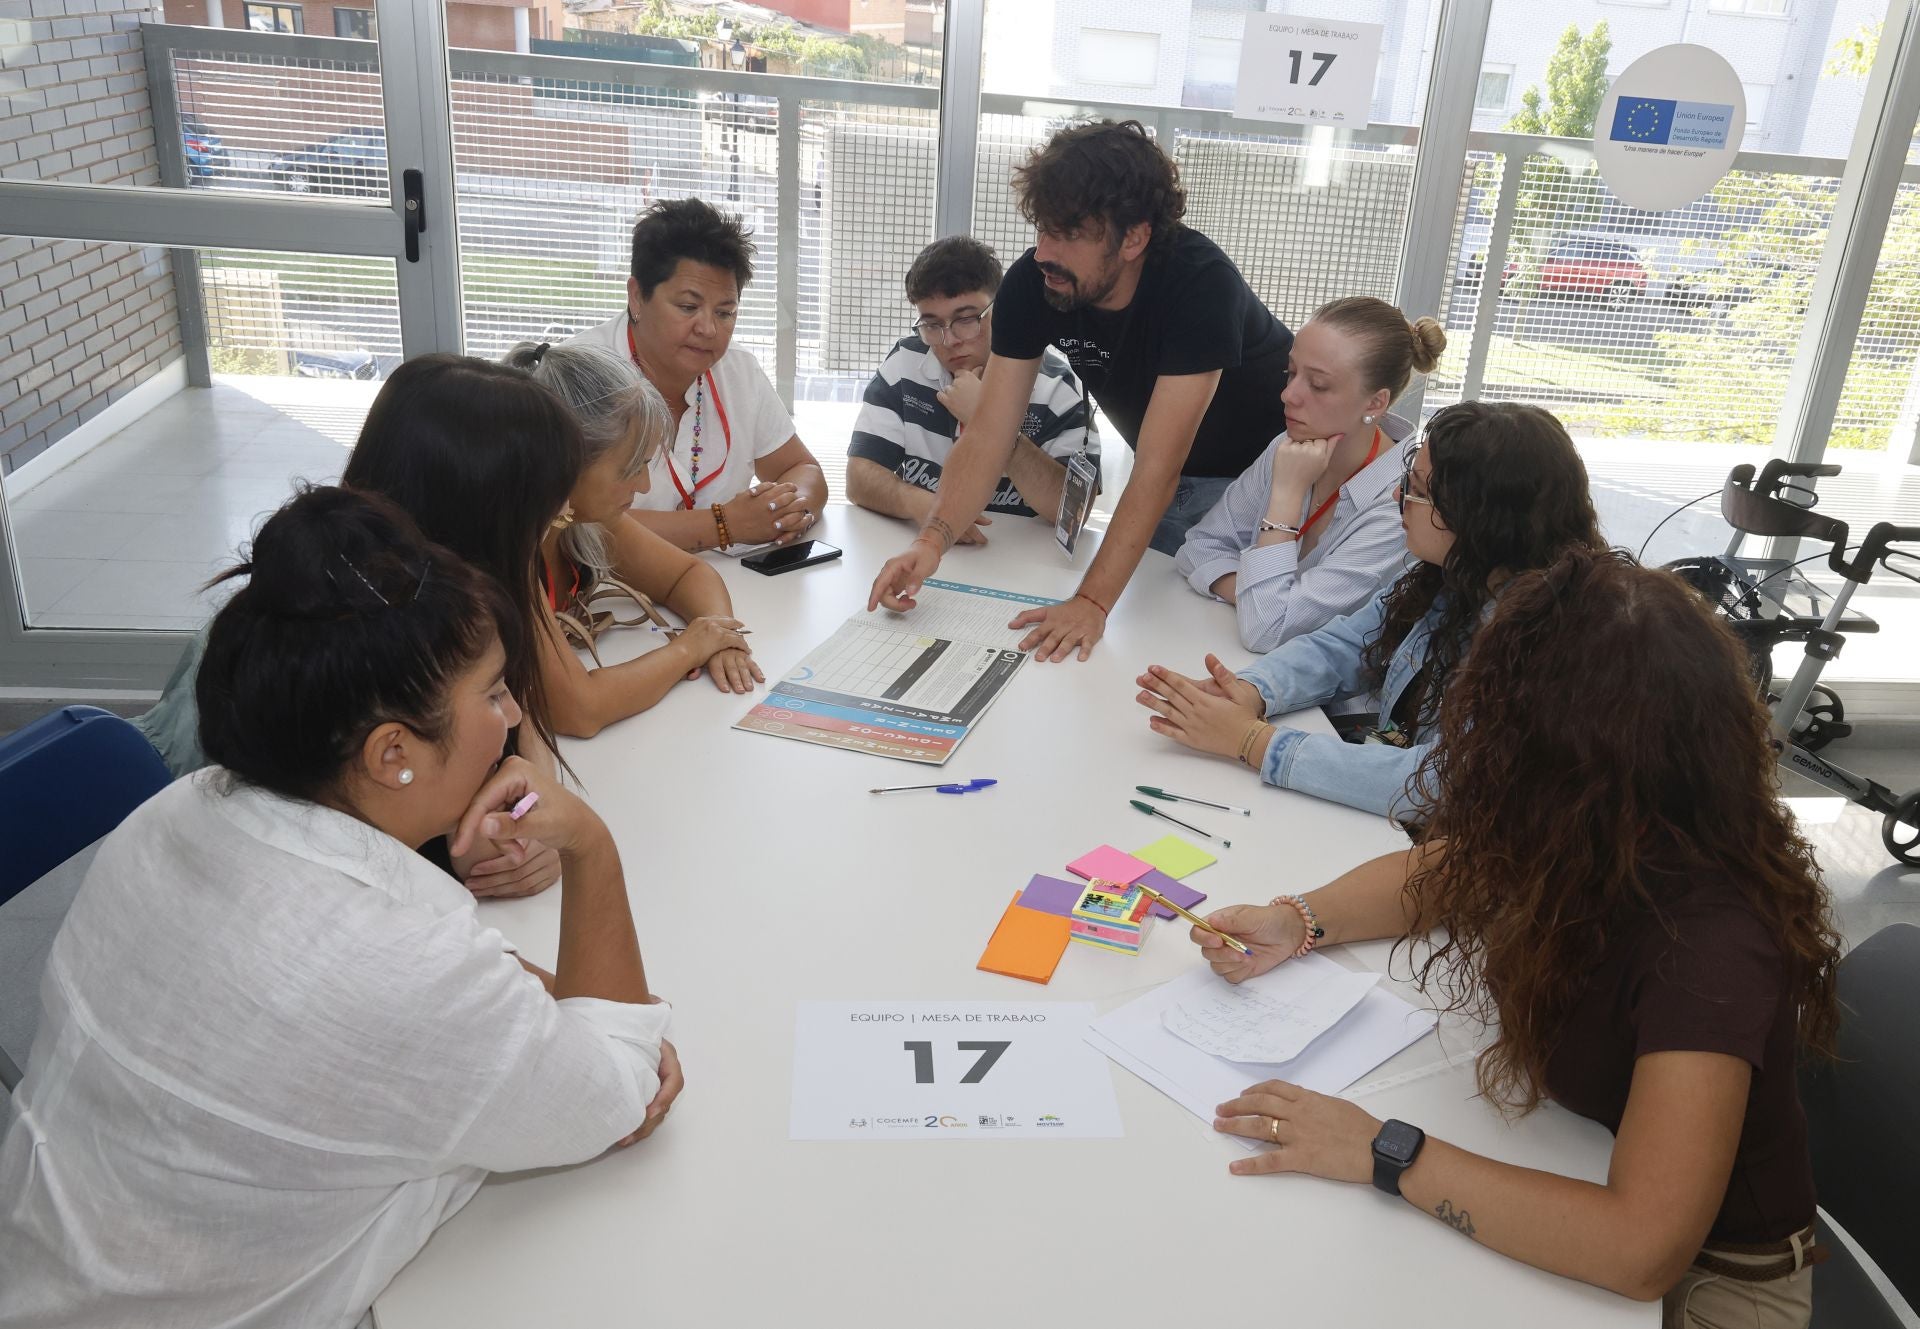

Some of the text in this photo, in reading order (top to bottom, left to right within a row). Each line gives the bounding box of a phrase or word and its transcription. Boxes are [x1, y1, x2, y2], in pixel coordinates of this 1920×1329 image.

[1268, 24, 1294, 34] EQUIPO
[1300, 28, 1319, 36] MESA
[1330, 31, 1359, 40] TRABAJO
[1288, 50, 1338, 86] 17
[1697, 112, 1725, 122] Europea
[1672, 135, 1724, 145] Desarrollo Regional
[1673, 127, 1690, 135] Fondo
[1691, 129, 1713, 138] Europeo
[1667, 147, 1683, 155] hacer
[859, 700, 963, 724] EMPATIZAR
[874, 717, 957, 735] DEFINIR
[806, 730, 938, 758] IMPLEMENTAR
[850, 1013, 905, 1023] EQUIPO
[921, 1013, 961, 1022] MESA
[965, 1013, 983, 1022] DE
[986, 1013, 1046, 1023] TRABAJO
[903, 1040, 1013, 1084] 17
